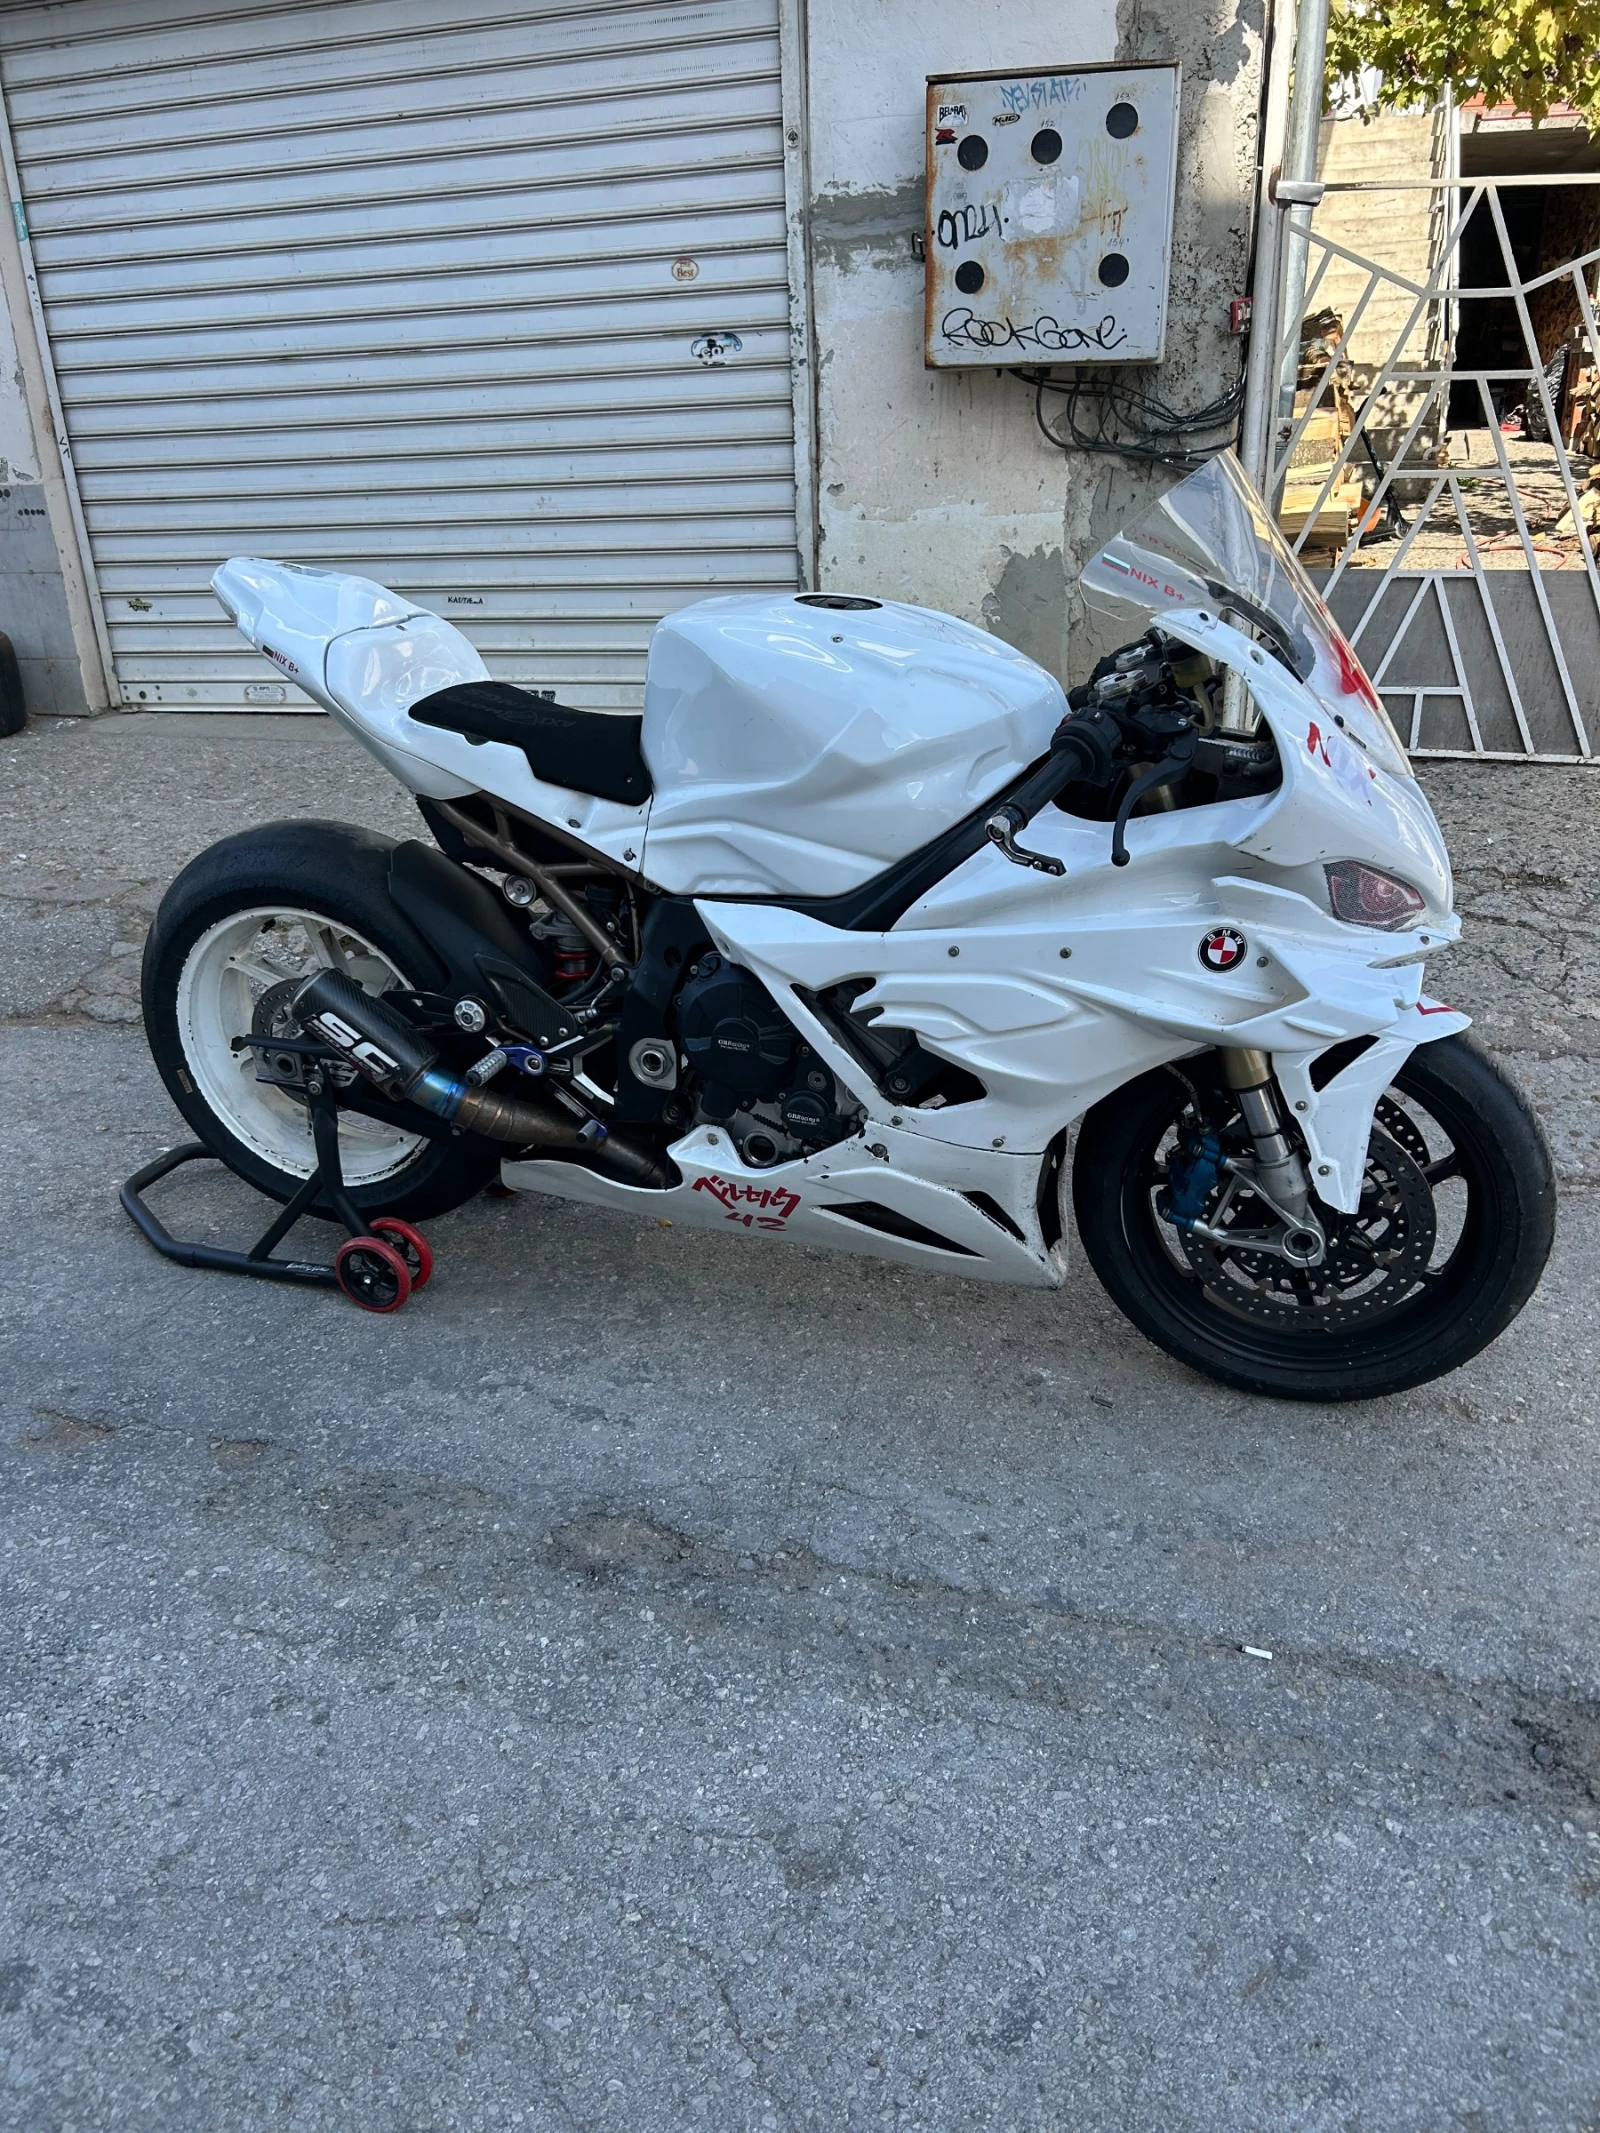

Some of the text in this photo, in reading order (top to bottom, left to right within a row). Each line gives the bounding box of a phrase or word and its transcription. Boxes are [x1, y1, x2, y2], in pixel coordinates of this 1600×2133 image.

[677, 267, 694, 278] Best
[1130, 567, 1185, 601] NIX B+
[273, 650, 300, 675] NIX B+
[1206, 929, 1245, 946] BMW
[312, 1011, 400, 1076] SC
[692, 1174, 802, 1219] ベルセルク
[724, 1211, 788, 1232] 42
